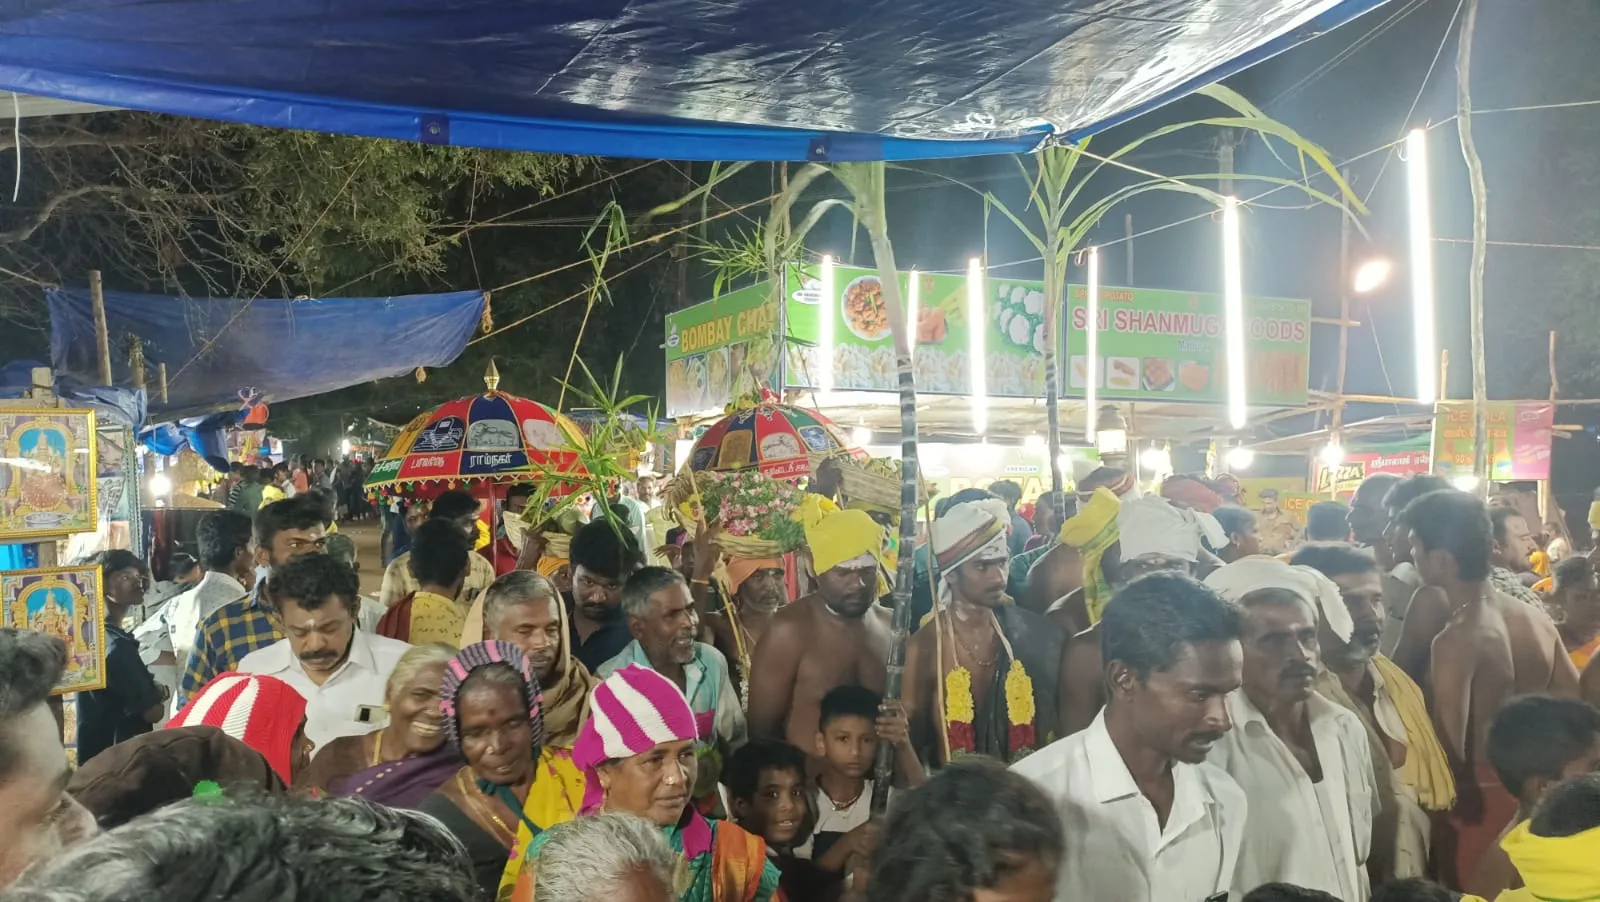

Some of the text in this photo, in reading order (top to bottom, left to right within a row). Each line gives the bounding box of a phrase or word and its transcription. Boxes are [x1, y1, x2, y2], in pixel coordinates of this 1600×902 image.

[681, 314, 733, 352] BOMBAY
[1114, 309, 1222, 338] SHANMUG
[1248, 318, 1307, 342] OODS
[1319, 464, 1363, 490] LZZA
[1284, 497, 1303, 510] ICE
